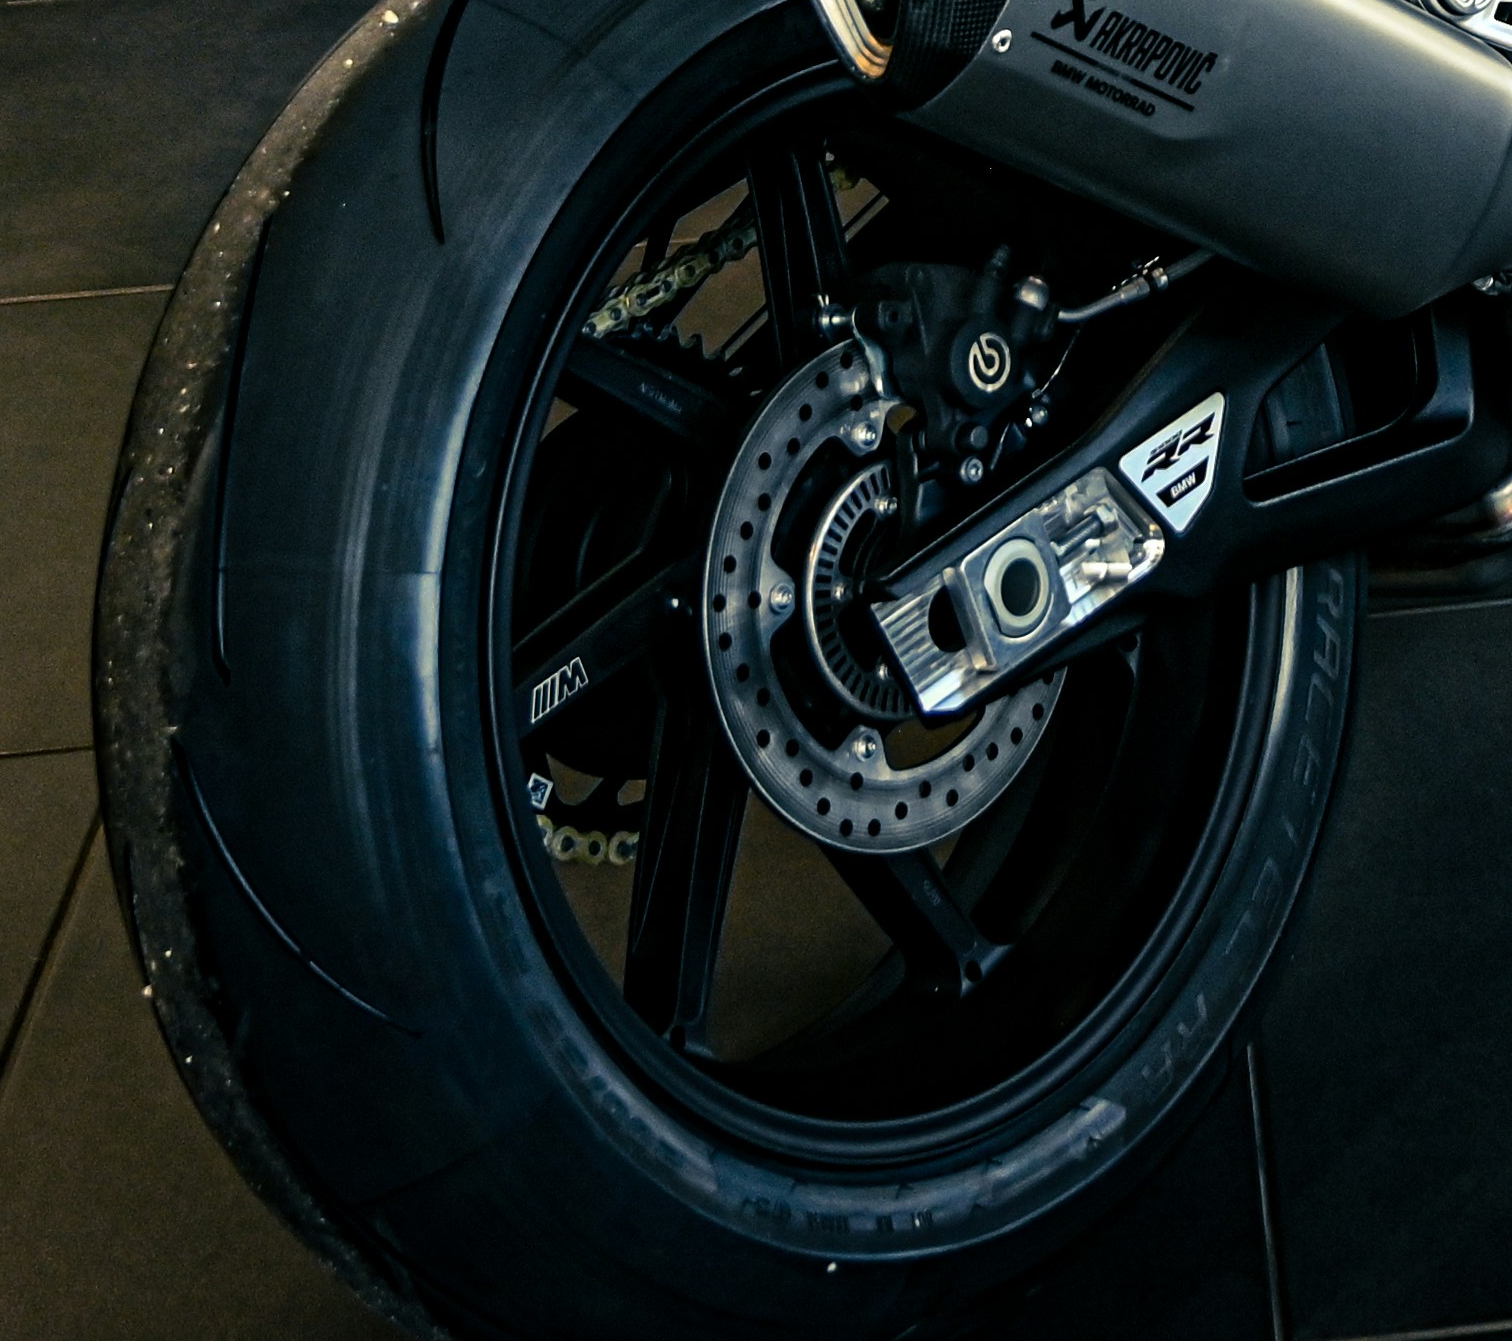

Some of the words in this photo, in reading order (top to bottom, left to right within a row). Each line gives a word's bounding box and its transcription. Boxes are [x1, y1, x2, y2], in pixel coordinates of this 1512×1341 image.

[1050, 59, 1086, 85] BMW
[1085, 75, 1156, 117] MOTORRAD
[1170, 471, 1197, 499] BMW
